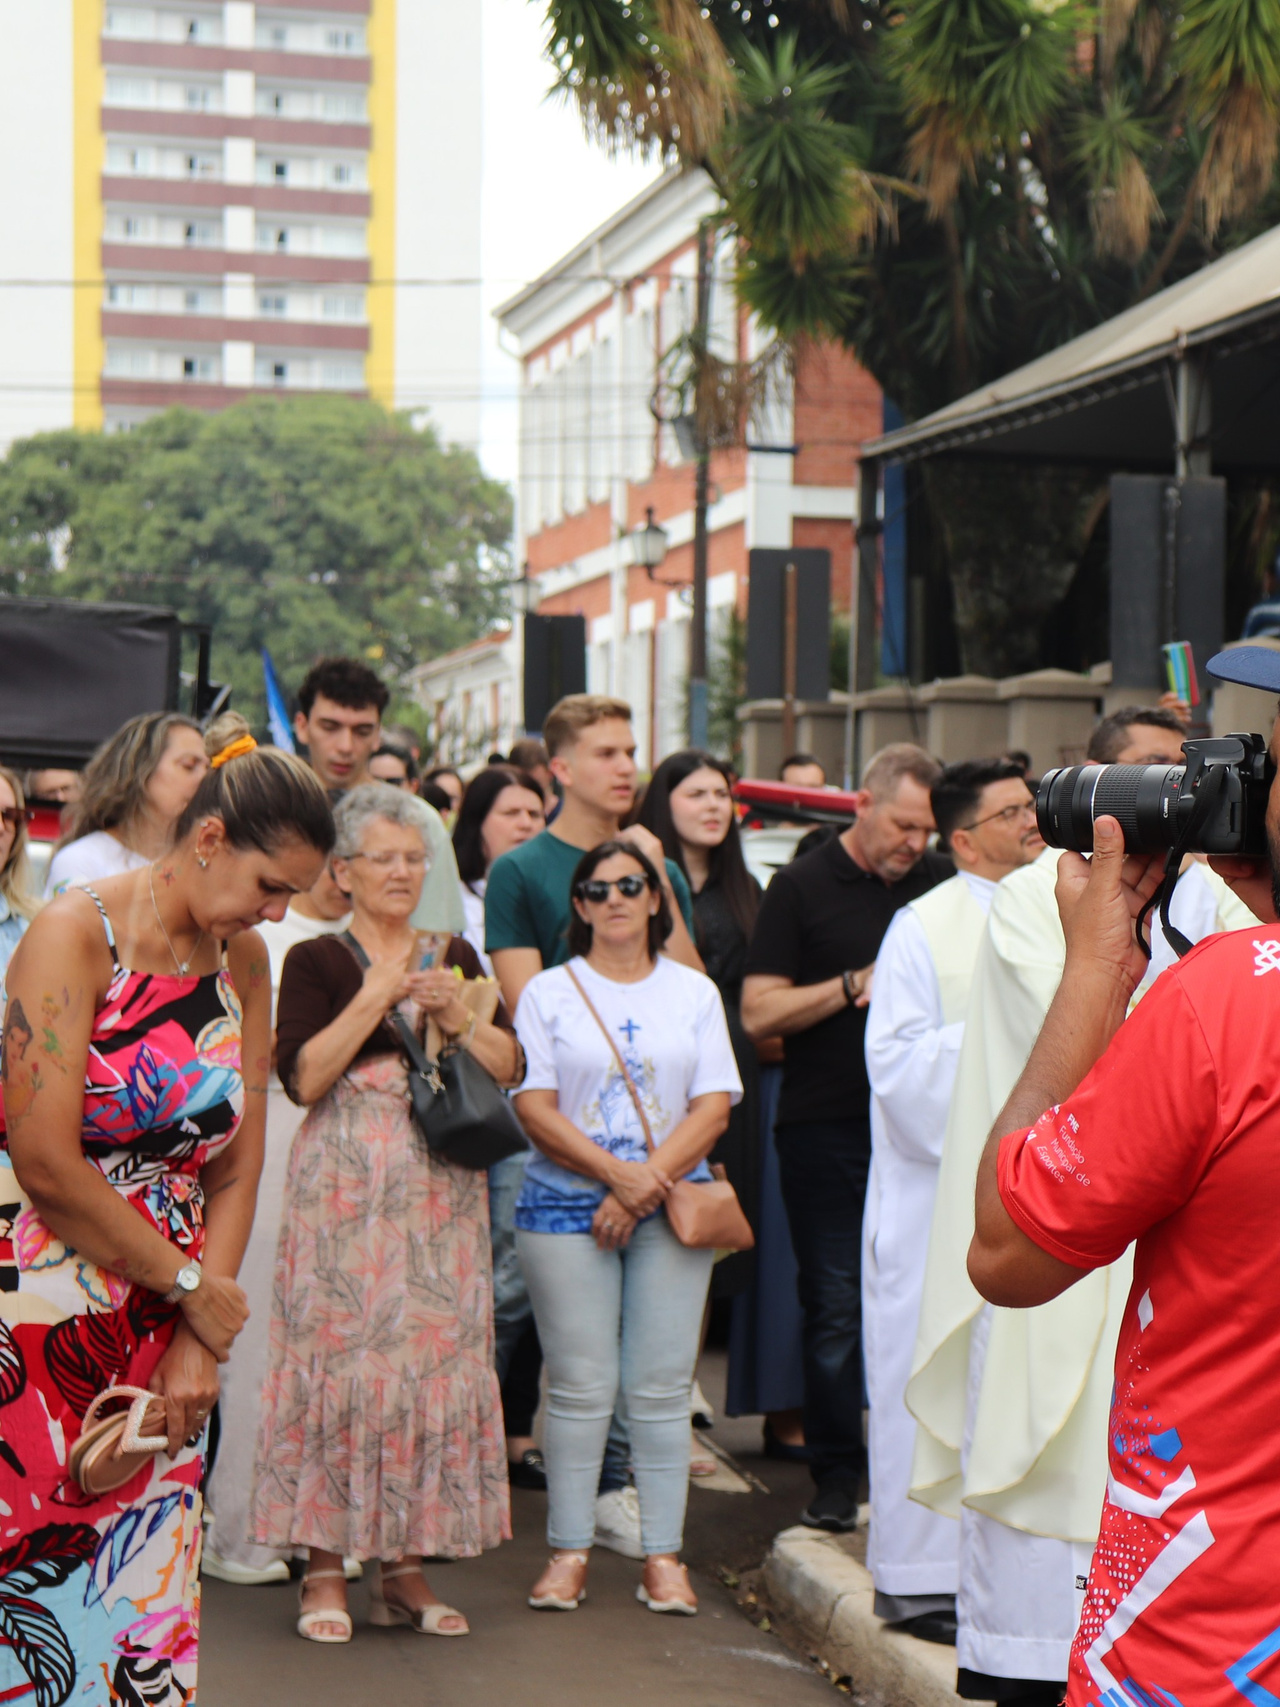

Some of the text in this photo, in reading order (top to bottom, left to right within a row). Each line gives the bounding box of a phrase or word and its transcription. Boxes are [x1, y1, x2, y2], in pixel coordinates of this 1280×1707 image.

[1058, 1125, 1085, 1164] Fundação
[1037, 1145, 1065, 1183] Esportes
[1076, 1172, 1091, 1187] de
